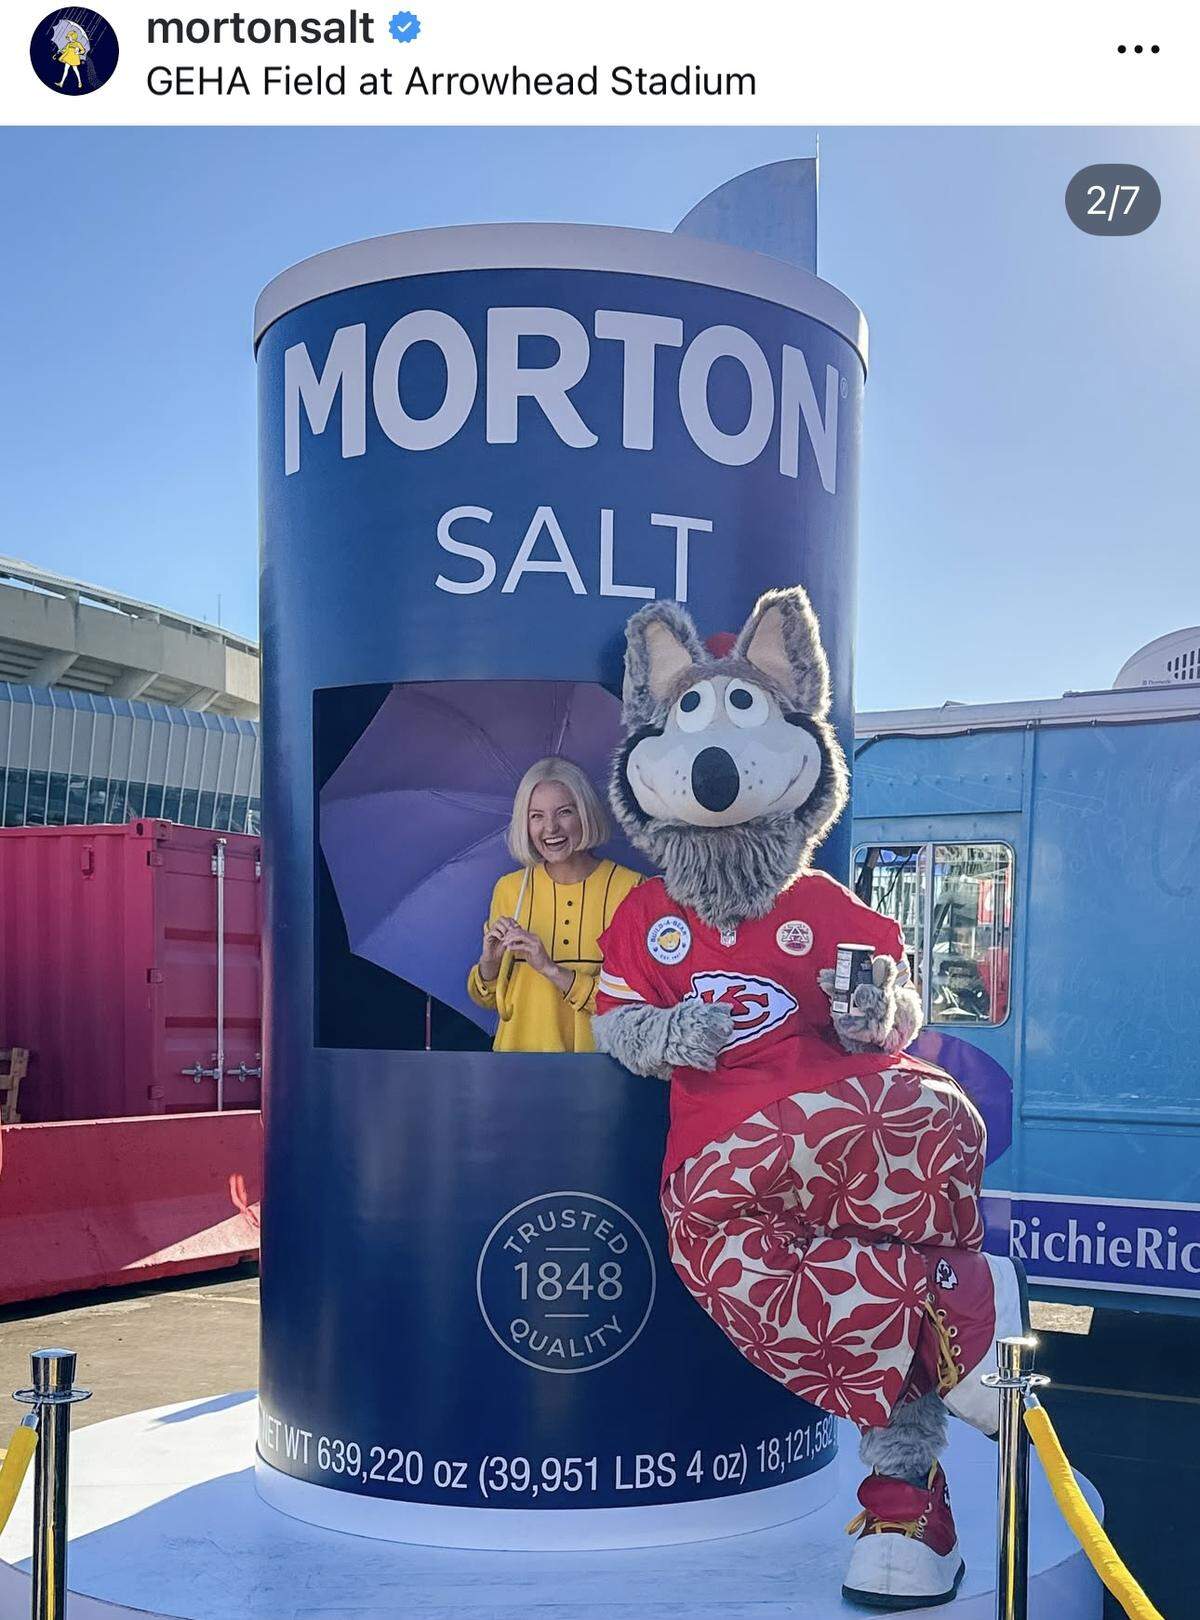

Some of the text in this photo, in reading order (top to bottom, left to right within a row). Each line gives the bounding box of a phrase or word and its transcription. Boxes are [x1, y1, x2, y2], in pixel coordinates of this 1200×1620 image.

[435, 505, 713, 603] SALT
[503, 1209, 629, 1255] TRUSTED
[513, 1261, 623, 1301] 1848
[509, 1314, 623, 1359] QUALITY
[284, 1423, 313, 1465] WT
[317, 1436, 423, 1485] 639,220
[433, 1460, 469, 1489] oz
[479, 1455, 598, 1498] (39,951
[615, 1452, 677, 1490] LBS
[686, 1450, 704, 1484] 4
[713, 1444, 748, 1485] oz)
